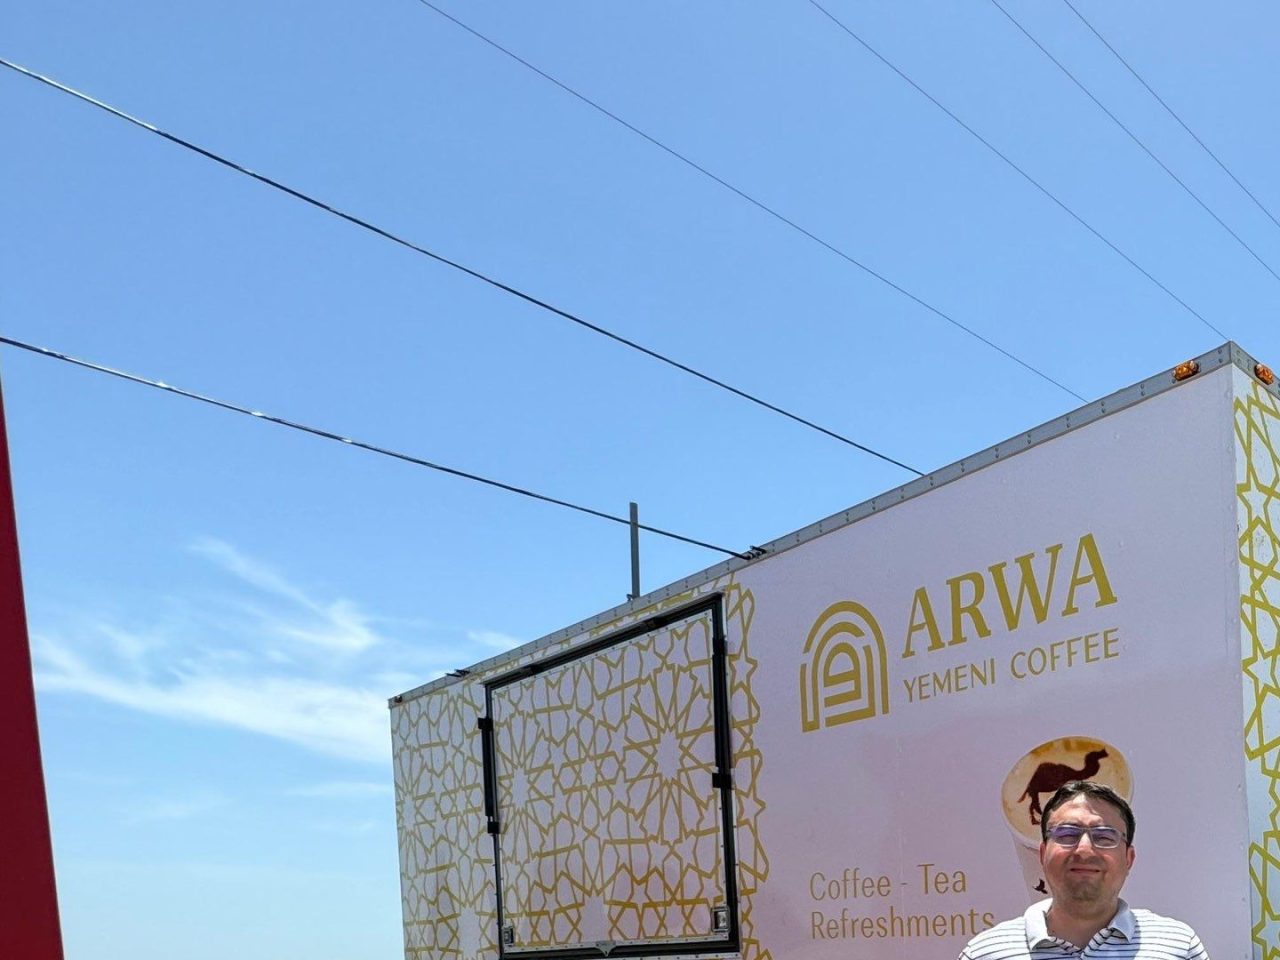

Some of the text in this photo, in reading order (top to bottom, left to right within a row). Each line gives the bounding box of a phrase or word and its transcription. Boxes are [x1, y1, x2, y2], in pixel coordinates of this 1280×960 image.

[902, 533, 1118, 658] ARWA
[902, 627, 1121, 703] YEMENI COFFEE
[809, 867, 891, 901] Coffee
[917, 863, 967, 895] Tea
[811, 905, 996, 940] Refreshments
